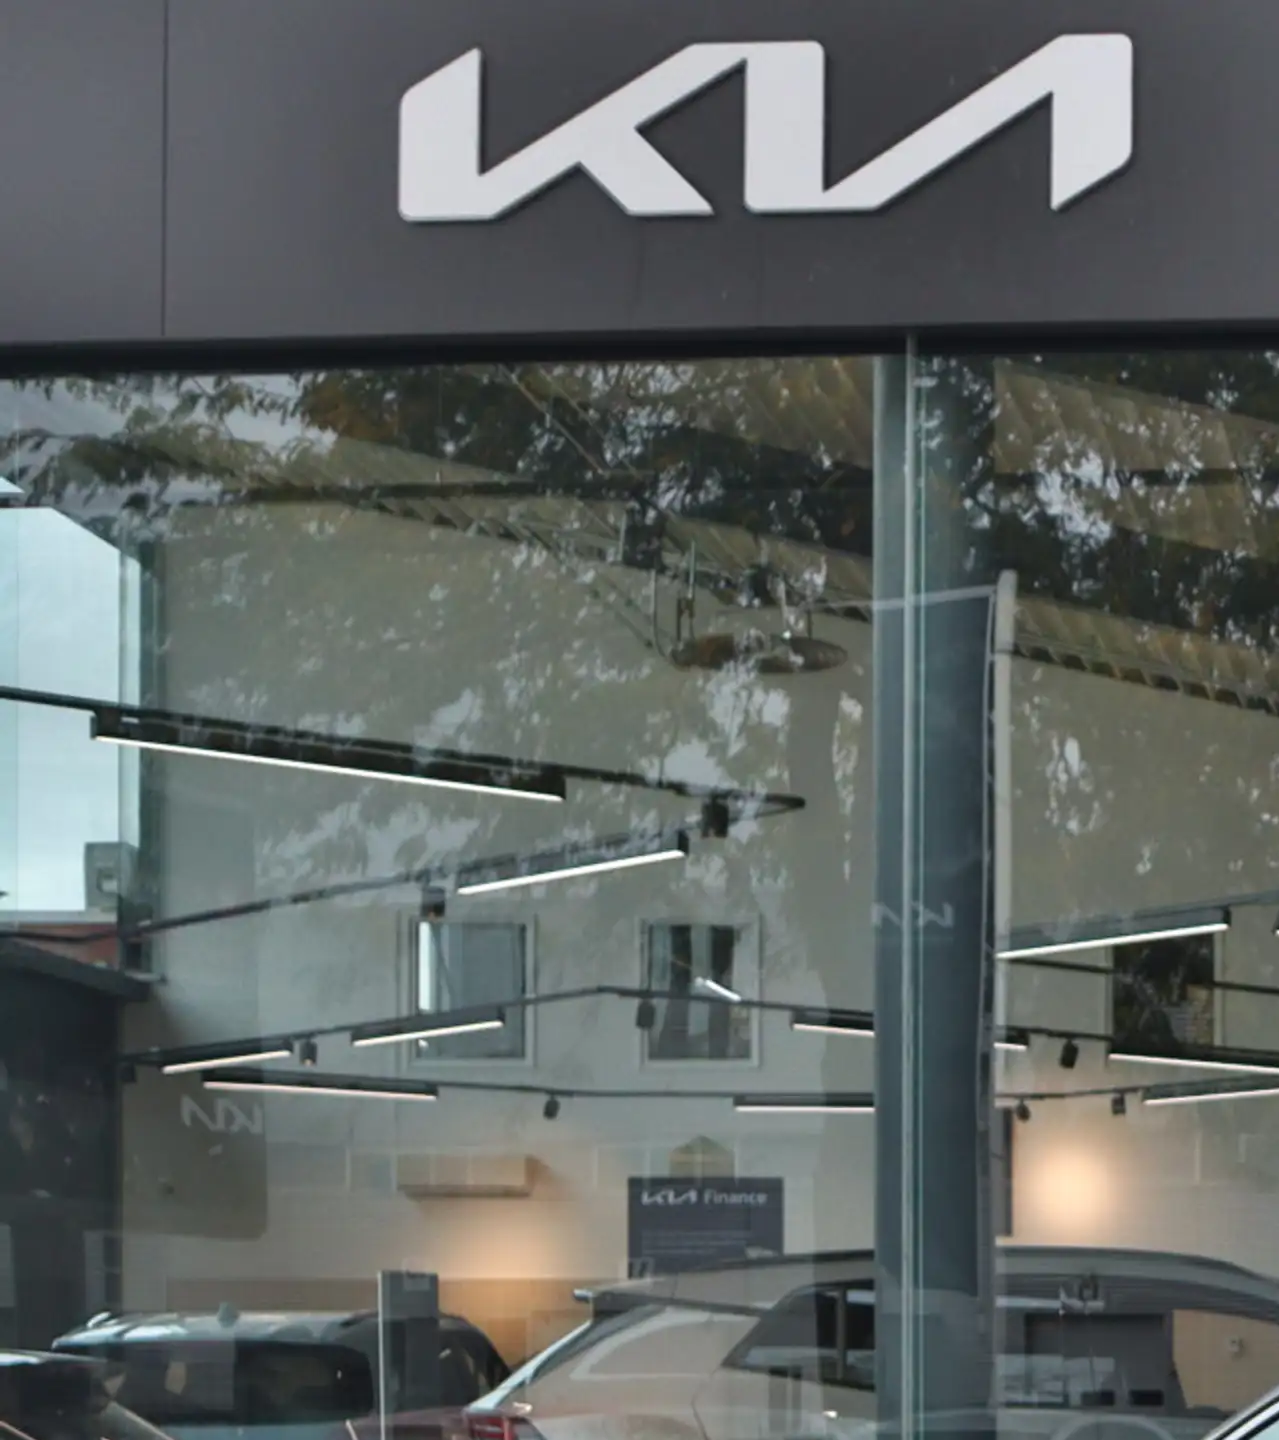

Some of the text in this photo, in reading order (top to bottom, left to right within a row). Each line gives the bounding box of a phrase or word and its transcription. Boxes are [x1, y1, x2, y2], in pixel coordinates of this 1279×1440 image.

[398, 33, 1134, 222] KIA
[641, 1188, 768, 1206] KIA Finance
